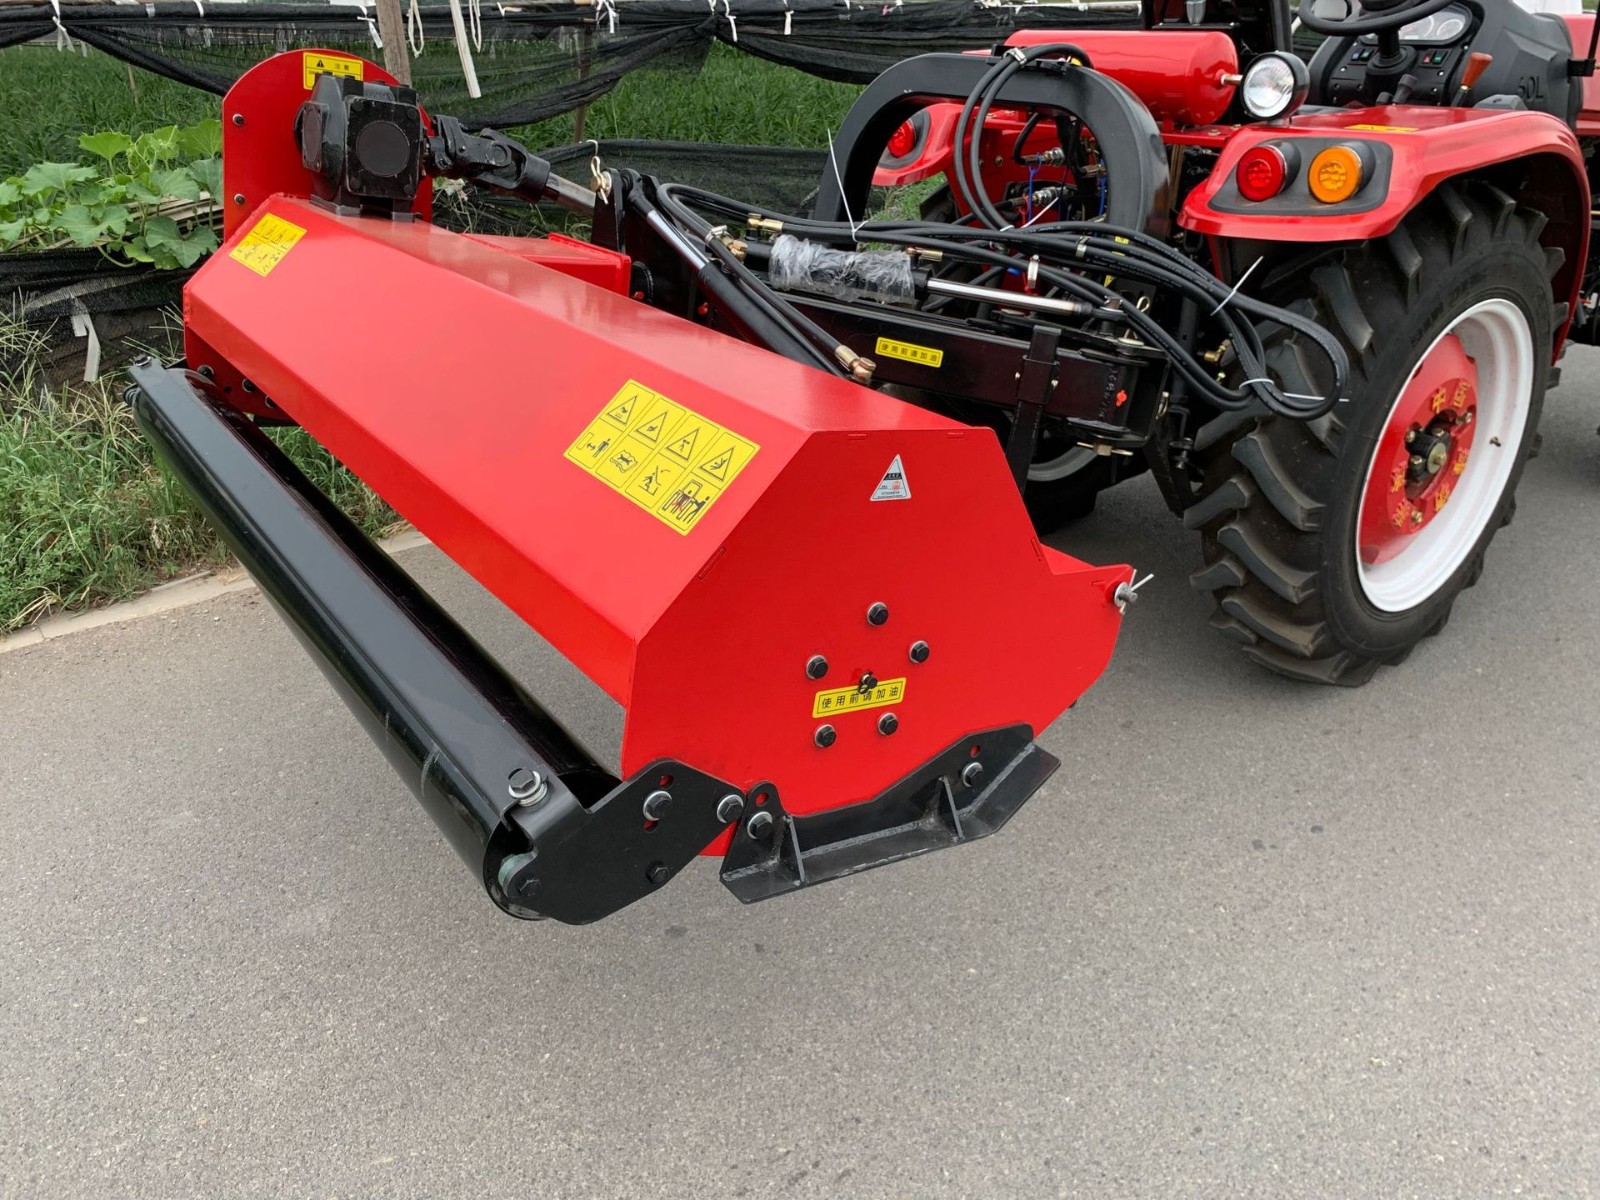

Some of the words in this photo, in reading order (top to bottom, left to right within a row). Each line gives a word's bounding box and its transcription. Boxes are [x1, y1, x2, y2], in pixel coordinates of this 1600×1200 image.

[880, 343, 938, 362] 使用前请加油
[821, 686, 899, 709] 使用前请加油
